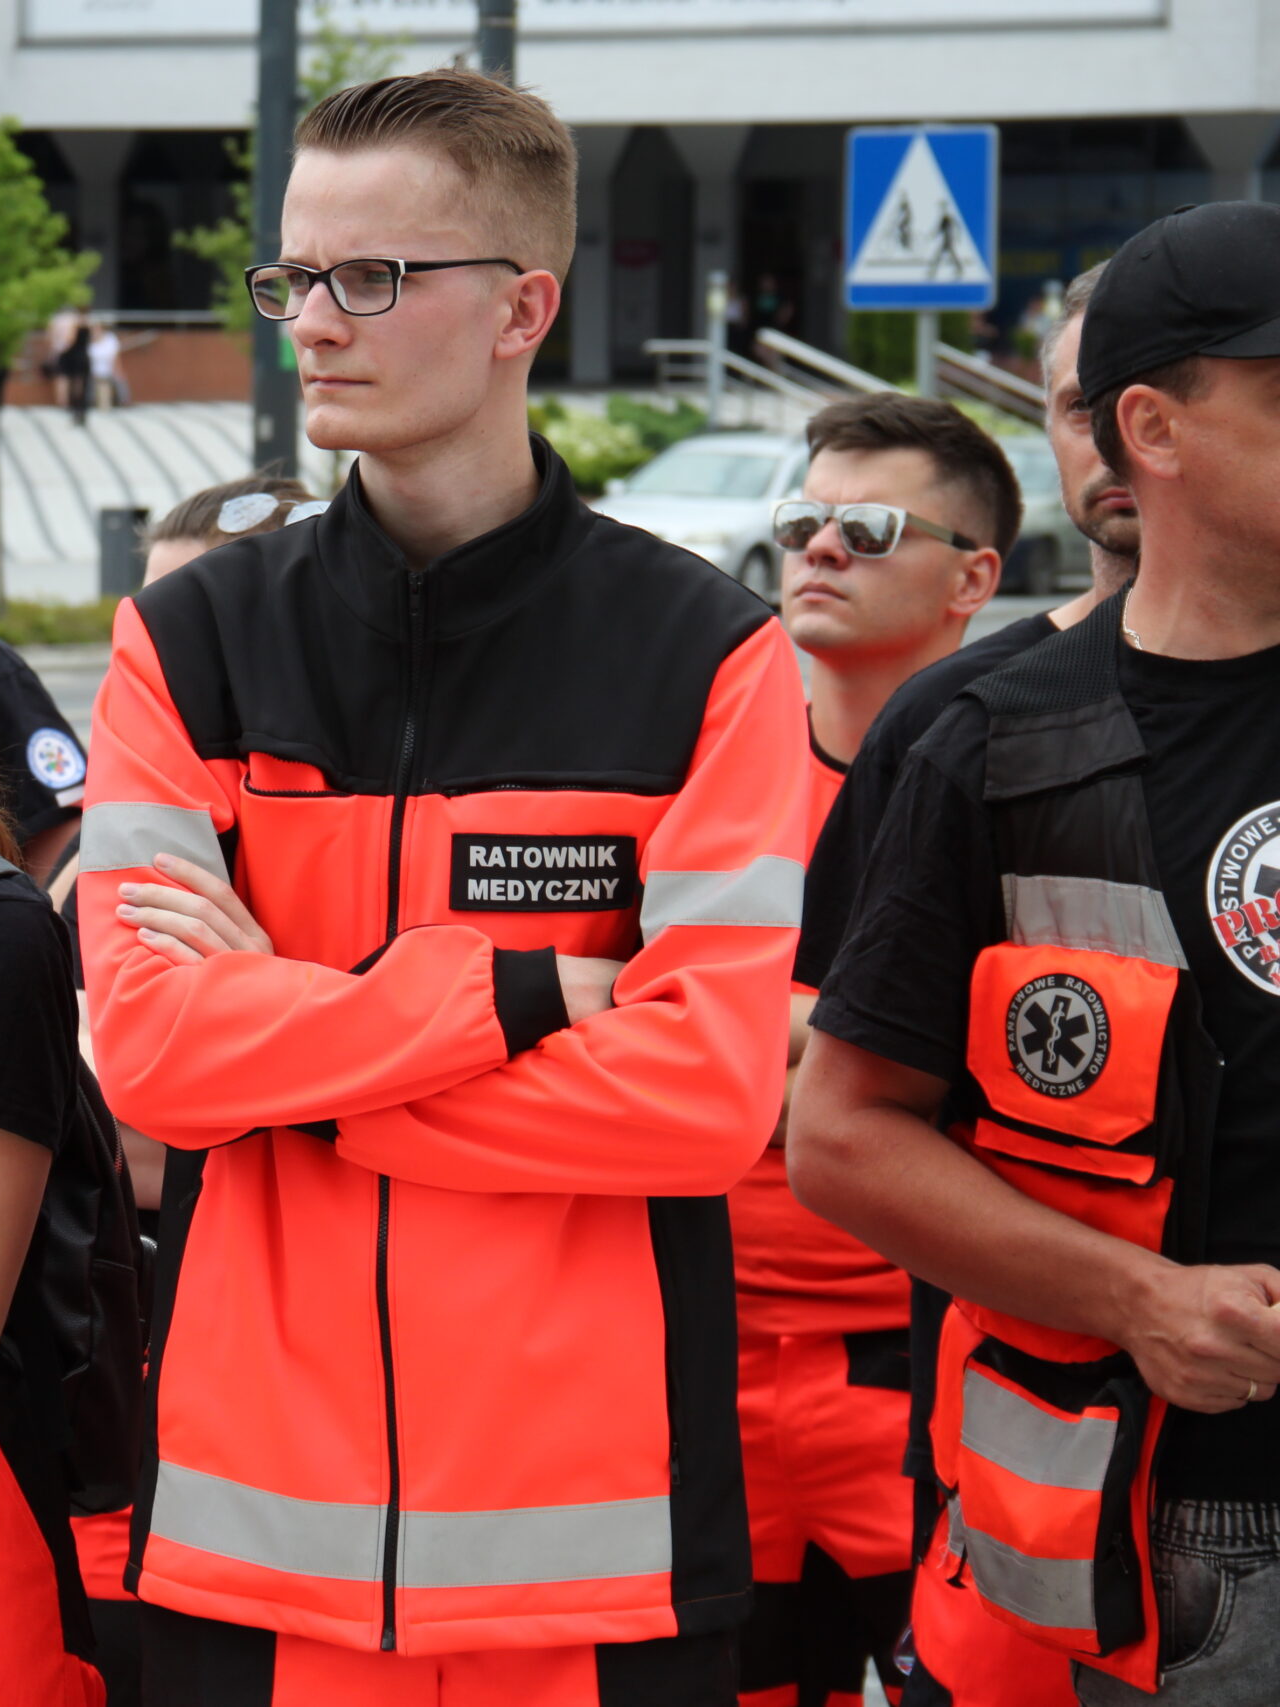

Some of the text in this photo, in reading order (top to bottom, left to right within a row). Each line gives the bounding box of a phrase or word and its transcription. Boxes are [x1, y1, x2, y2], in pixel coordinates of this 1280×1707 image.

[469, 845, 618, 869] RATOWNIK
[467, 878, 620, 902] MEDYCZNY
[1221, 817, 1277, 960] PASTWOWE
[1066, 977, 1108, 1075] RATOWNICTWO
[1016, 1061, 1086, 1096] MEDYCZNE
